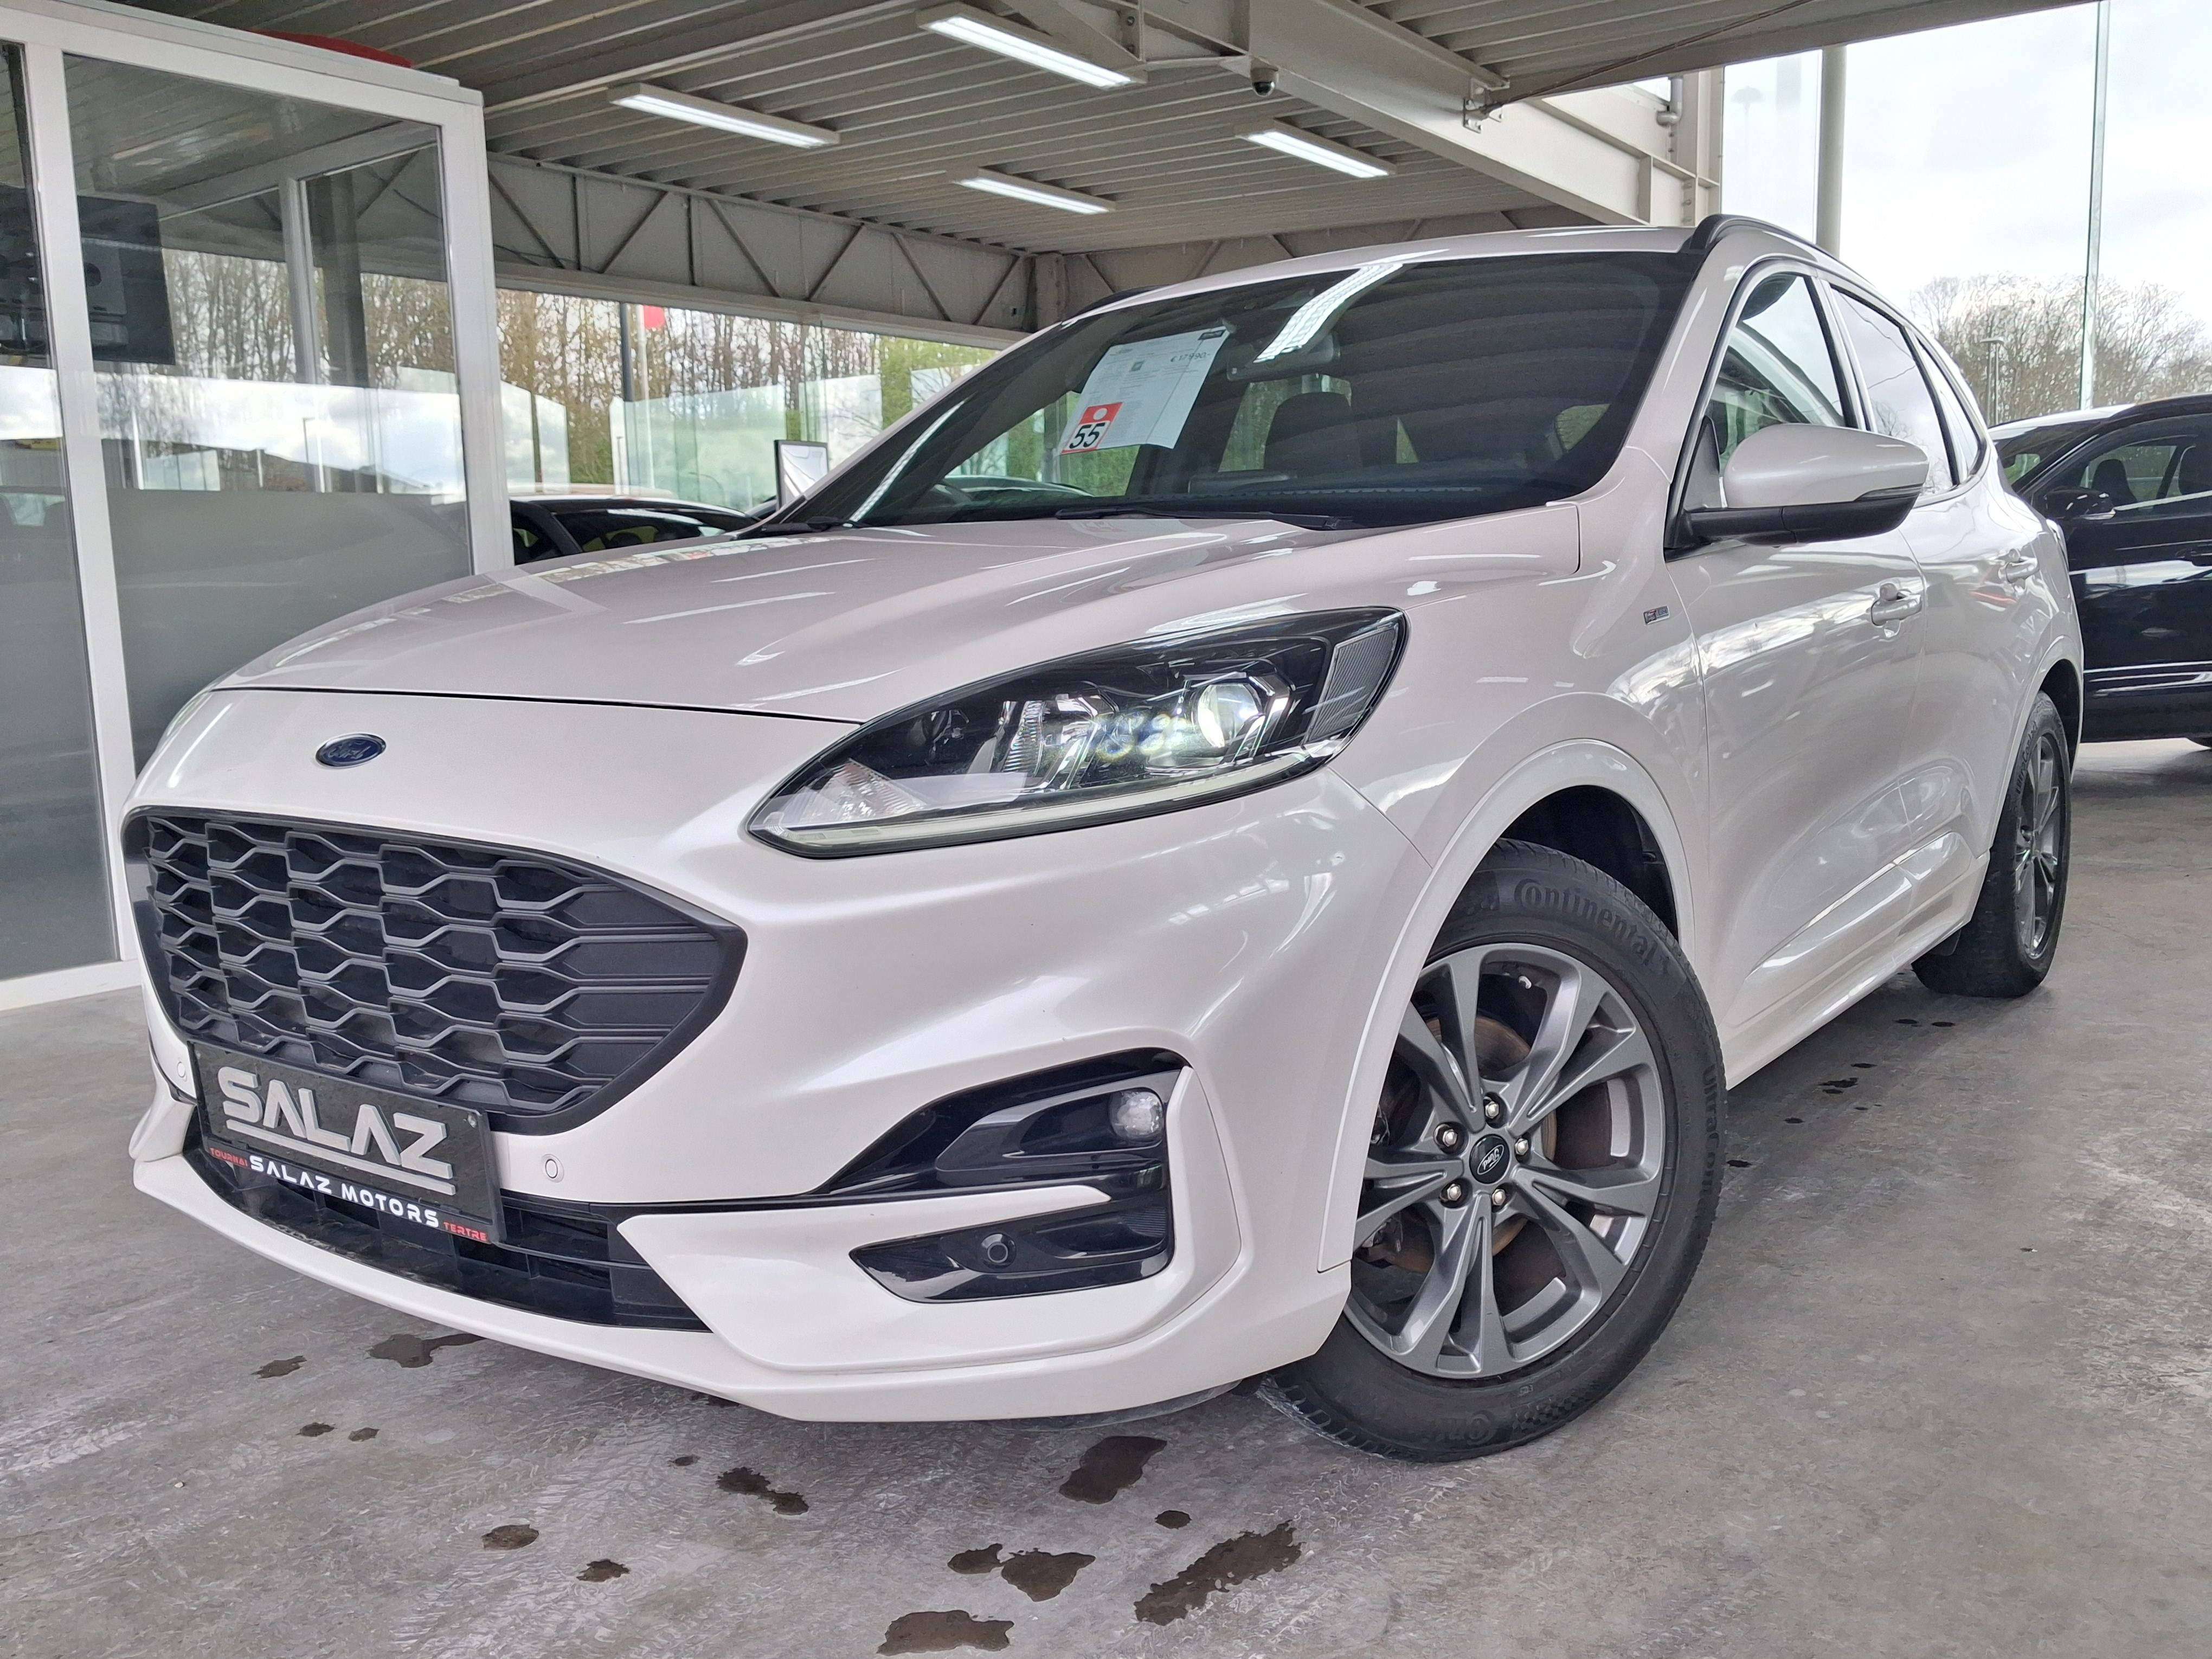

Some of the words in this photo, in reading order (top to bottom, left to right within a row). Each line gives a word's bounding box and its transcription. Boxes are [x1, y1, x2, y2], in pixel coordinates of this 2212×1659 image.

[1069, 422, 1105, 448] 55
[1514, 878, 1658, 967] Continental
[218, 1066, 453, 1180] SALAZ
[1481, 1147, 1500, 1171] Ford
[249, 1155, 332, 1194] SALAZ
[341, 1182, 439, 1228] MOTORS
[442, 1221, 487, 1242] TERTRE
